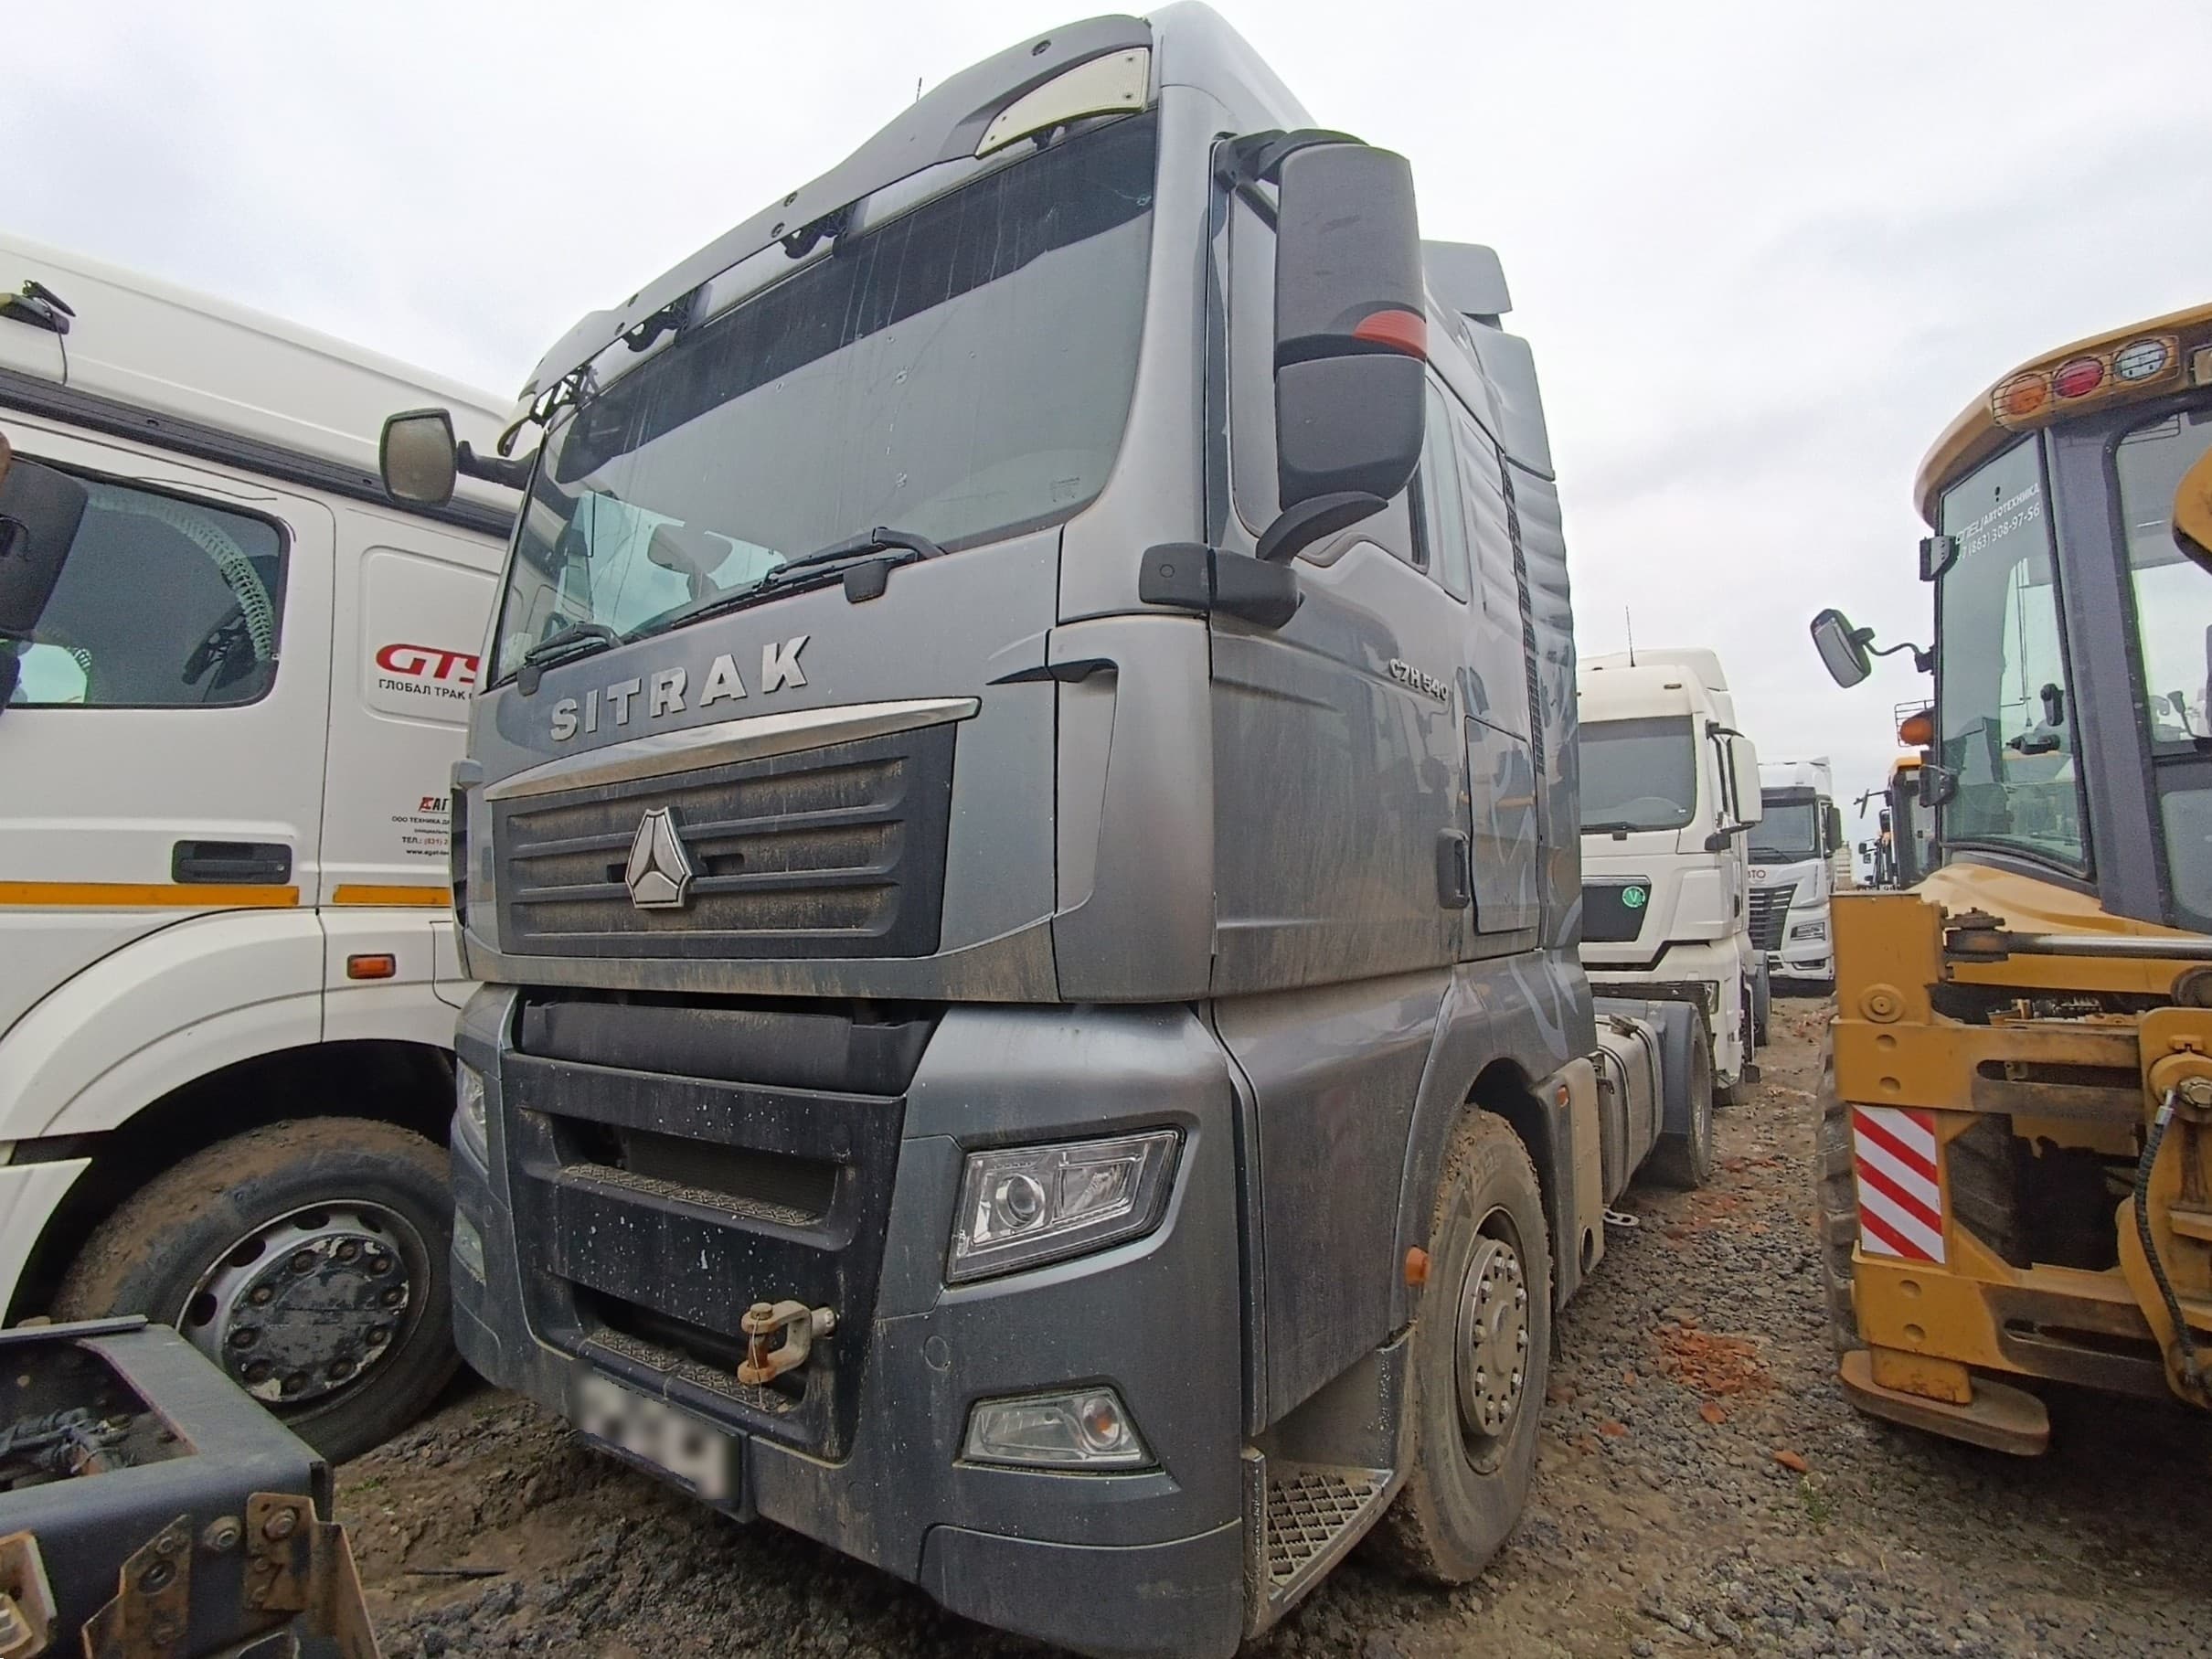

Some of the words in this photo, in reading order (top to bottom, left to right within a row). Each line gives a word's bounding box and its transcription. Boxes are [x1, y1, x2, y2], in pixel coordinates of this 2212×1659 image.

[378, 679, 431, 696] ГЛОБАЛ
[434, 686, 466, 700] ТРАК
[550, 635, 811, 742] SITRAK
[1389, 657, 1420, 688] C7H
[1420, 672, 1449, 702] 540
[409, 816, 441, 824] ТЕХНИКА
